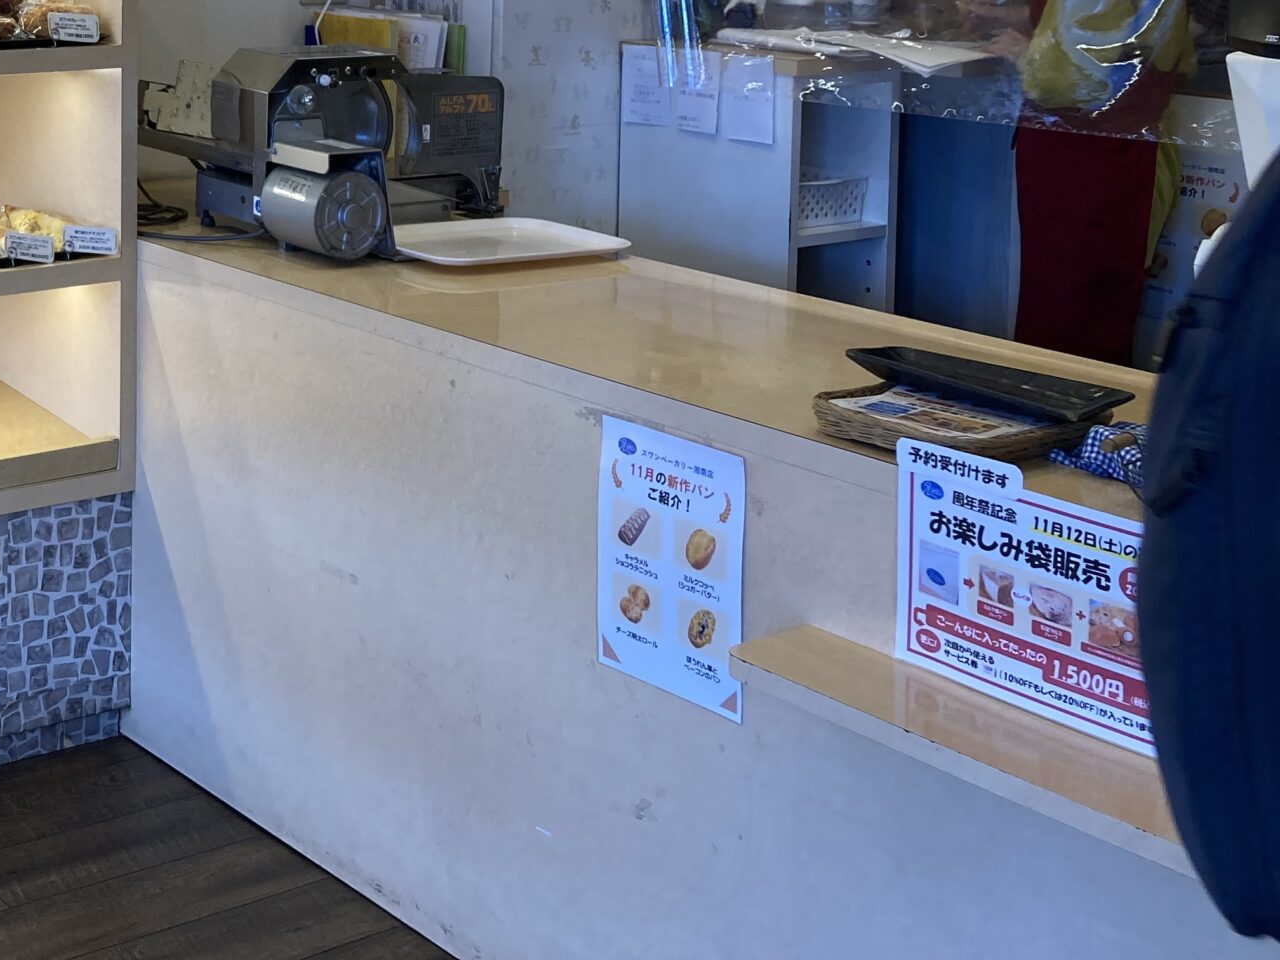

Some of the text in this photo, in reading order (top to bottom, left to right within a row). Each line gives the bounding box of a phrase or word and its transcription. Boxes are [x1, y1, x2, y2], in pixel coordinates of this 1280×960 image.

[641, 449, 714, 479] スワンベーカリー湘南店
[908, 446, 1009, 489] 予約受付けます
[630, 462, 714, 499] 11月の新作パン
[648, 487, 690, 512] ご紹介！
[952, 490, 1018, 525] 周年祭記念
[1034, 516, 1141, 560] 11月12日(土)の
[624, 553, 649, 568] キャラメル
[929, 510, 1111, 592] お楽しみ袋販売
[678, 581, 720, 602] (シュガーバター)
[683, 574, 715, 591] ミルクコッペ
[615, 626, 658, 648] チーズ明太ロール
[936, 615, 1047, 664] こーんなに入ってたったの
[686, 655, 718, 674] ほうれん草と
[944, 639, 995, 665] 次回から使える
[944, 649, 978, 669] サービス券
[684, 664, 721, 683] ベーコンのパン
